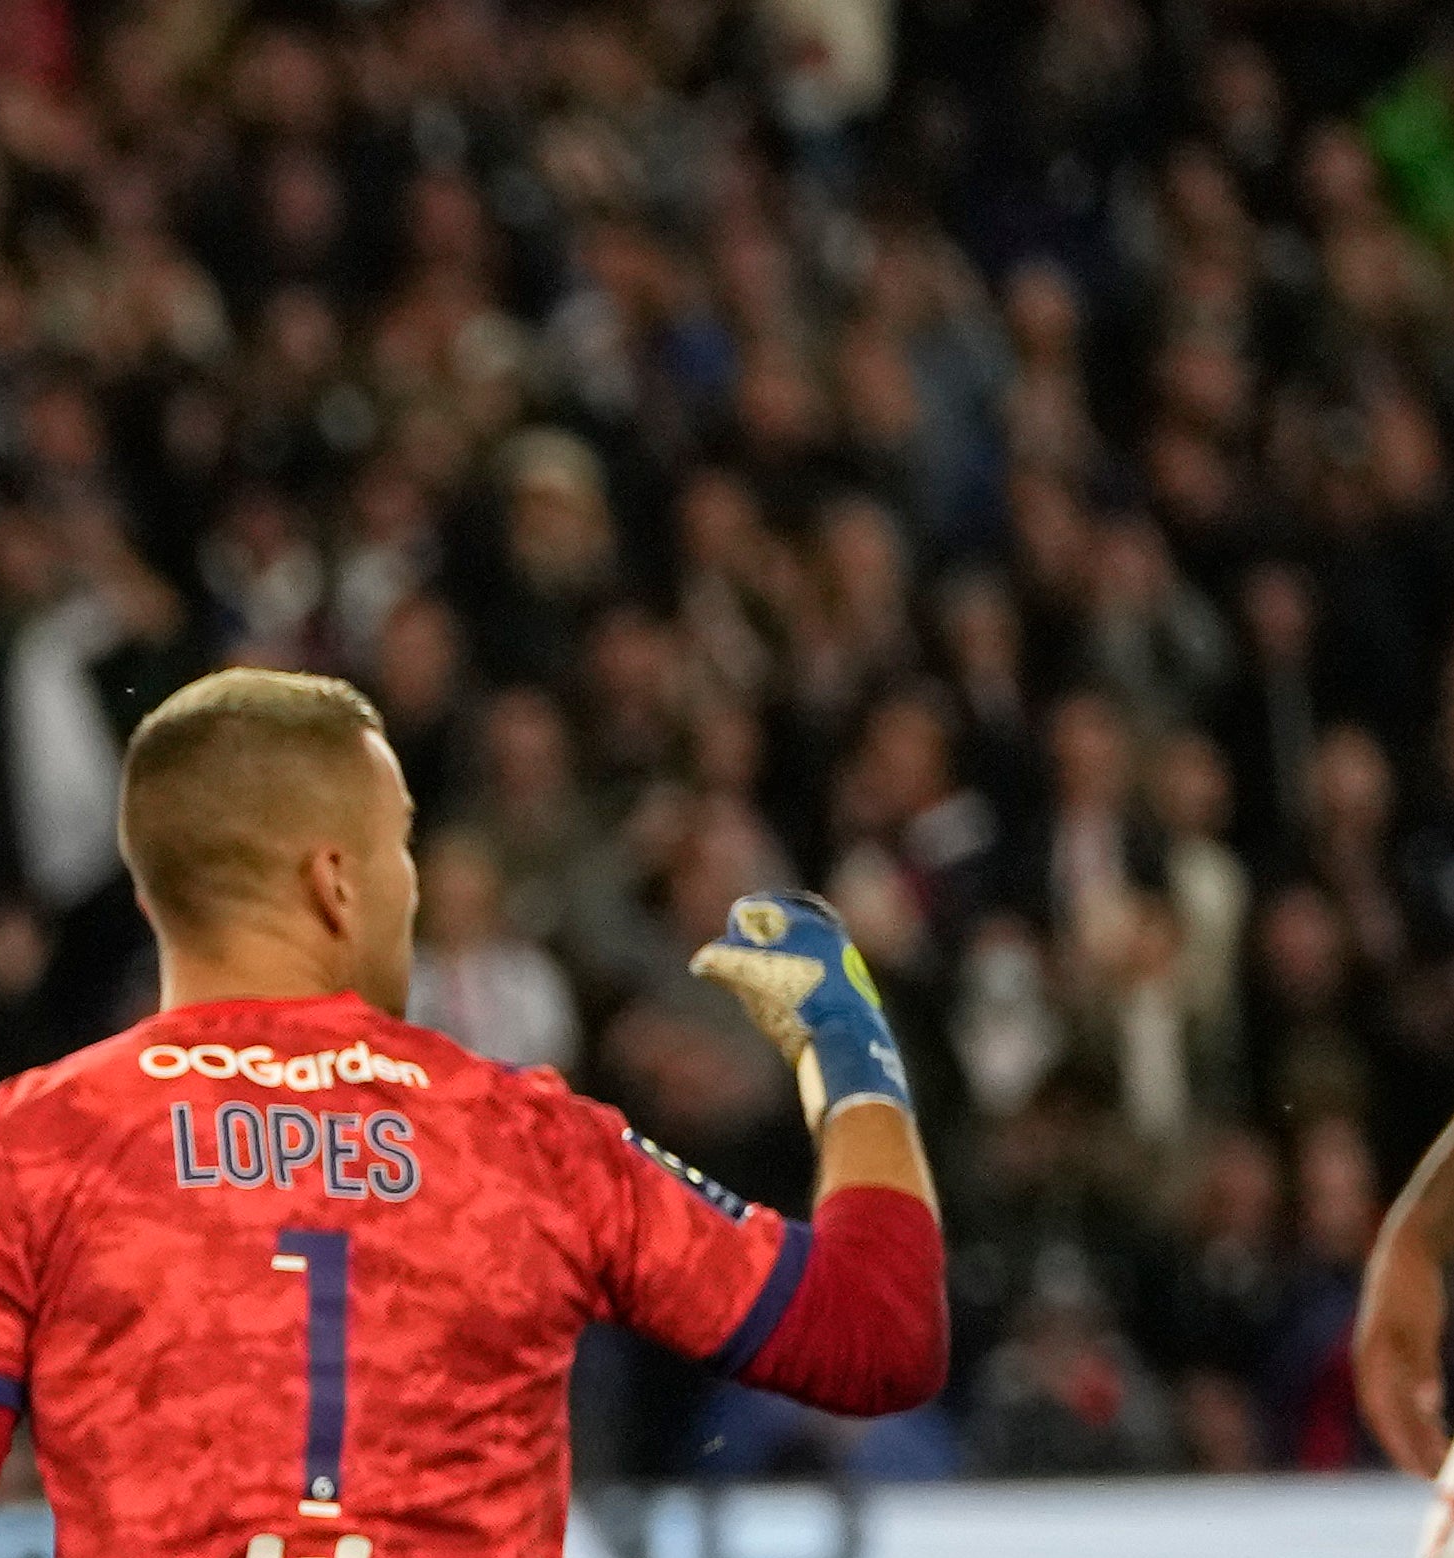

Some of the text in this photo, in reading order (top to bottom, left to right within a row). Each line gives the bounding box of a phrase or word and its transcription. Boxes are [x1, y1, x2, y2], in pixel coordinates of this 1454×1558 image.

[138, 1040, 431, 1092] OOGarden
[170, 1100, 422, 1203] LOPES
[270, 1229, 349, 1518] 1
